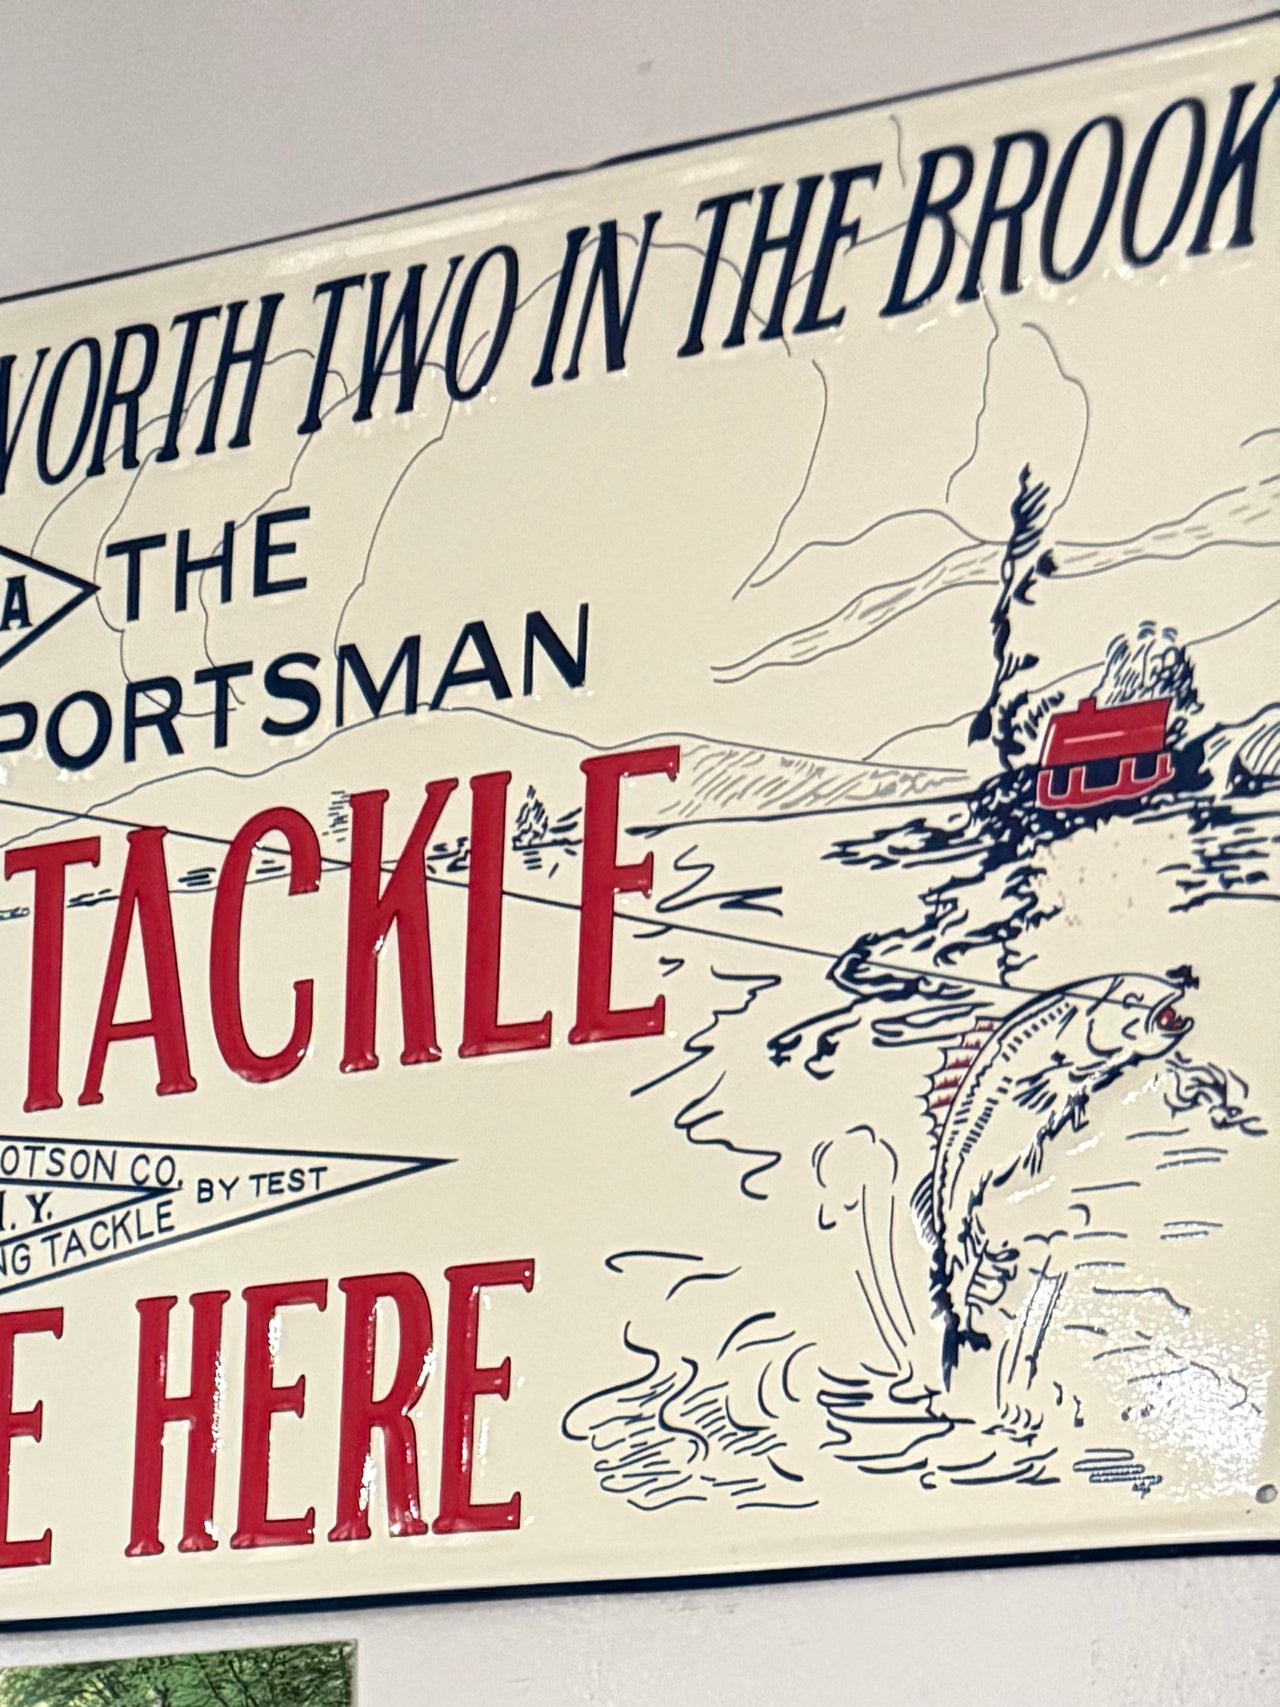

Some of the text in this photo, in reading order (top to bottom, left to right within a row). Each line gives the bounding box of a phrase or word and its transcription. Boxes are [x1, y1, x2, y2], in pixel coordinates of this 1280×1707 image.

[303, 243, 519, 434] TWO
[531, 211, 661, 390] IN
[676, 162, 882, 358] THE
[879, 76, 1280, 319] BROOK
[106, 505, 312, 622] THE
[4, 746, 681, 1114] TACKLE
[128, 1153, 183, 1190] CO.
[197, 1165, 328, 1203] BY TEST
[40, 1199, 176, 1267] TACKLE
[124, 1257, 537, 1558] HERE
